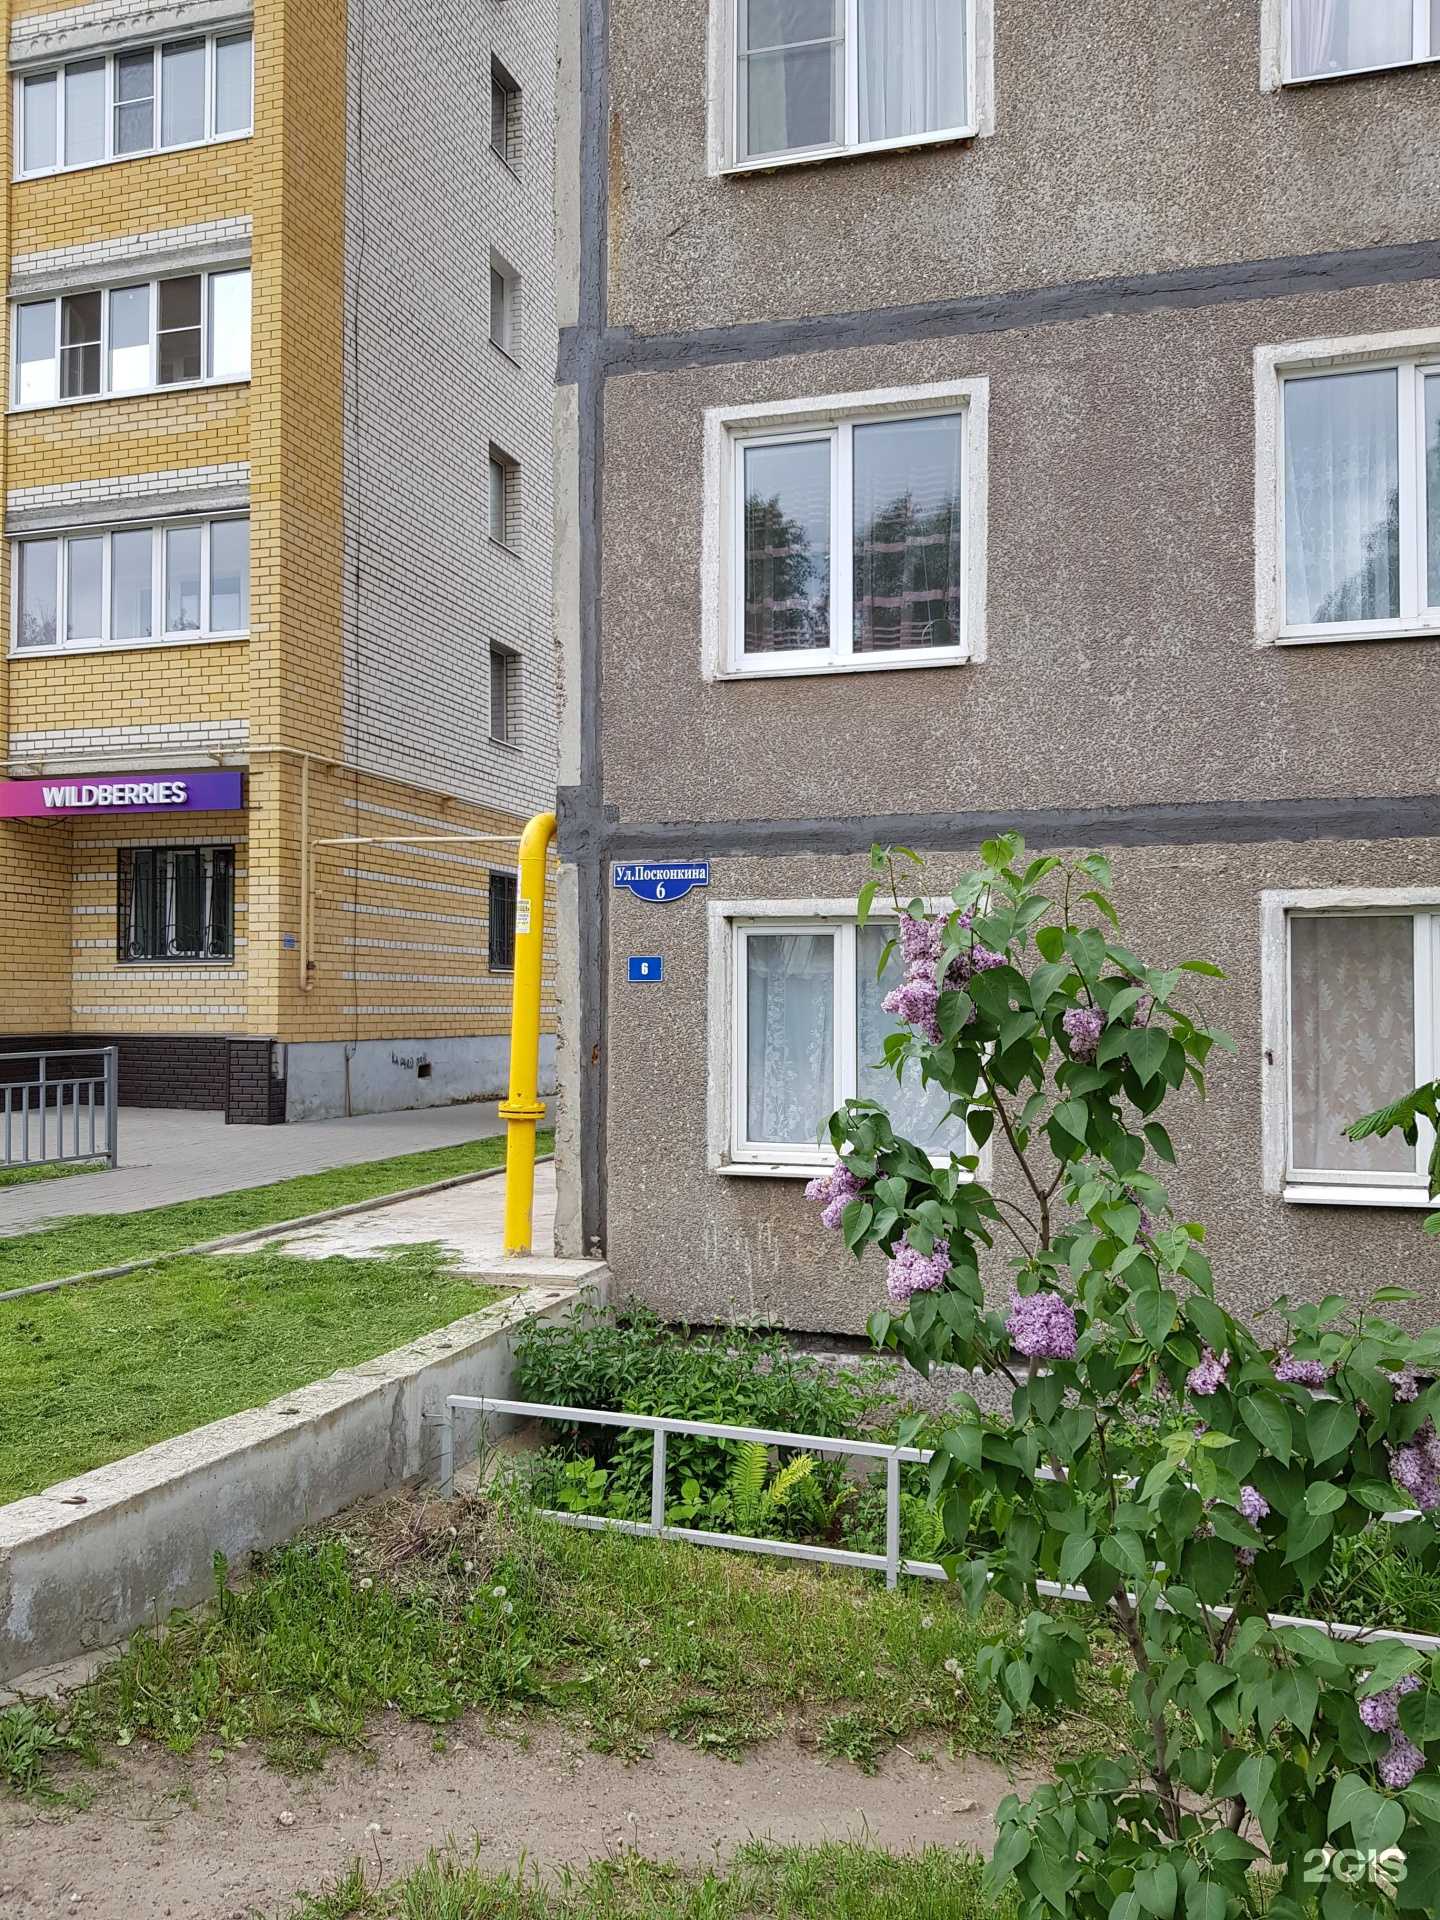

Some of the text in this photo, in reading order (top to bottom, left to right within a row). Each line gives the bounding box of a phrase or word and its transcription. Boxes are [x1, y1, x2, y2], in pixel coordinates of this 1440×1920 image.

[42, 781, 187, 807] WILDBERRIES
[616, 866, 706, 881] Ул.Посконкина
[656, 881, 666, 899] 6
[641, 962, 649, 975] 6
